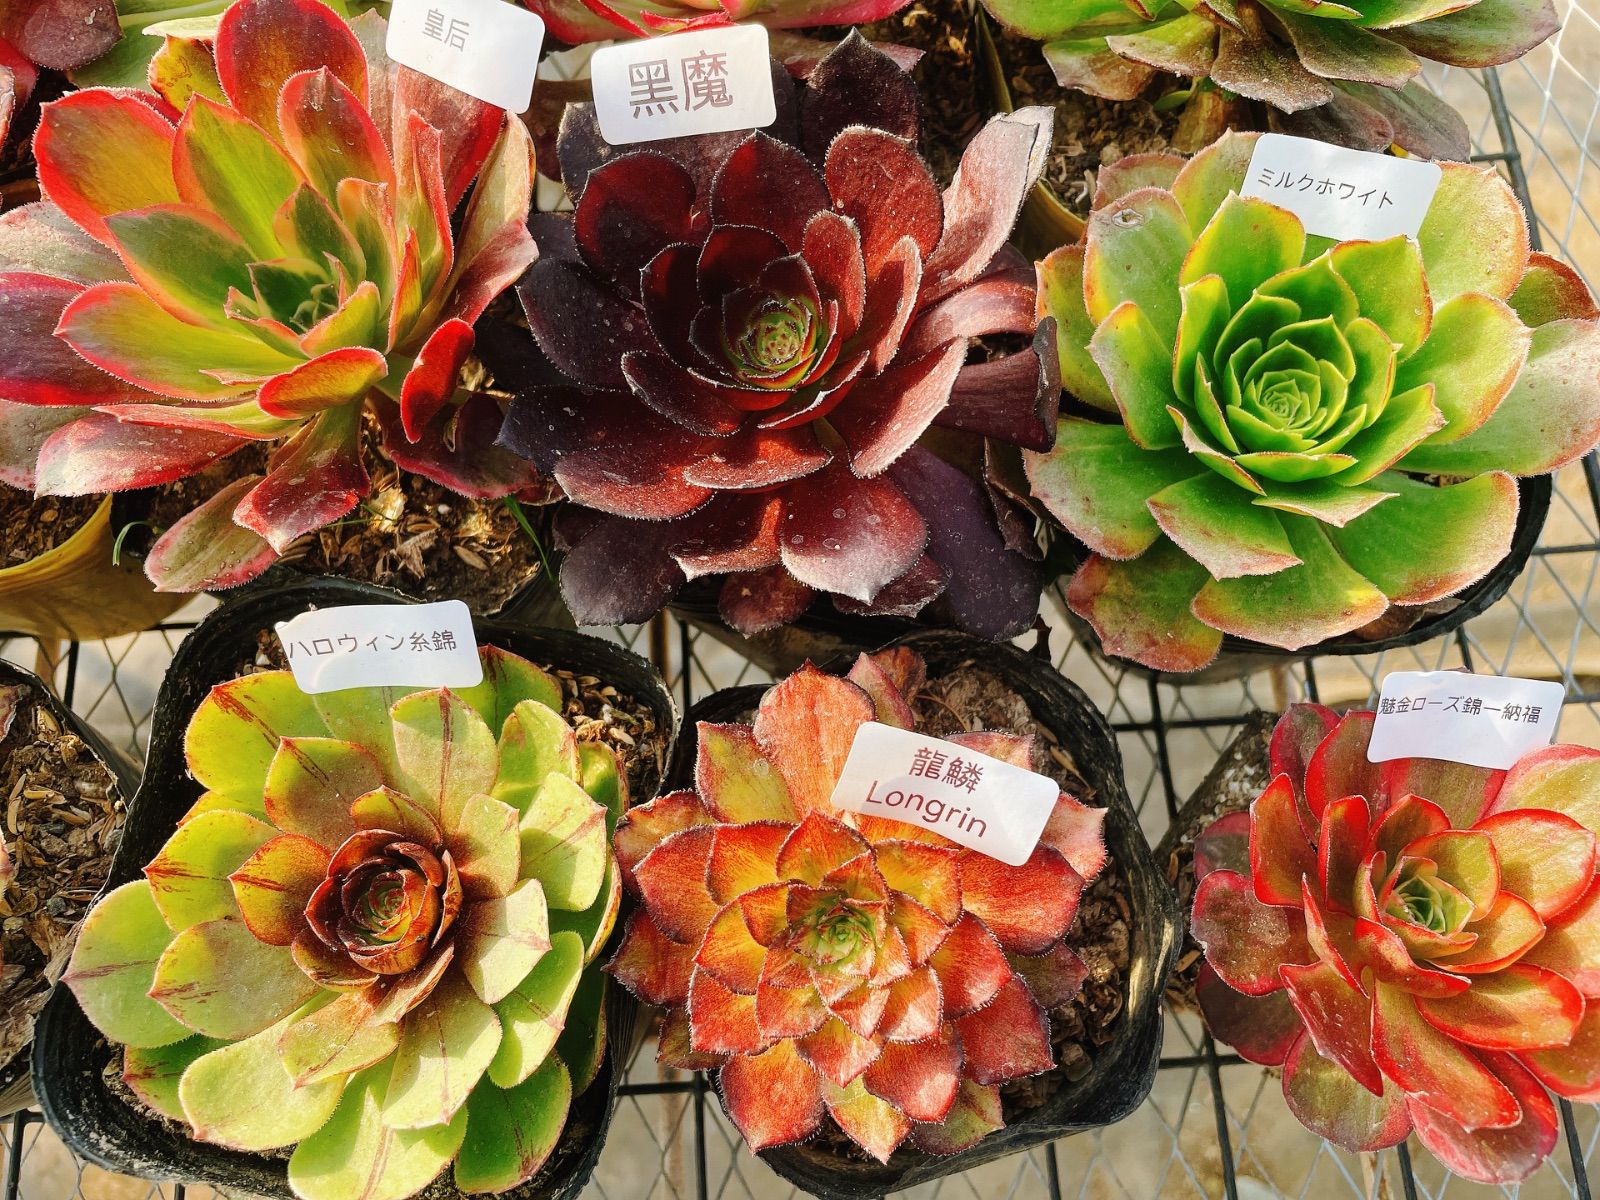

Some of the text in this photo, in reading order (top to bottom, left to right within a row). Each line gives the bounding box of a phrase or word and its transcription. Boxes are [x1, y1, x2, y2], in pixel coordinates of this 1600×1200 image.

[422, 8, 470, 52] 皇后
[628, 48, 733, 119] 黑魔
[1257, 166, 1395, 211] ミルクホワイト
[289, 629, 457, 659] ハロウィン糸錦
[908, 746, 984, 794] 龍鱗
[865, 780, 988, 838] Longrin
